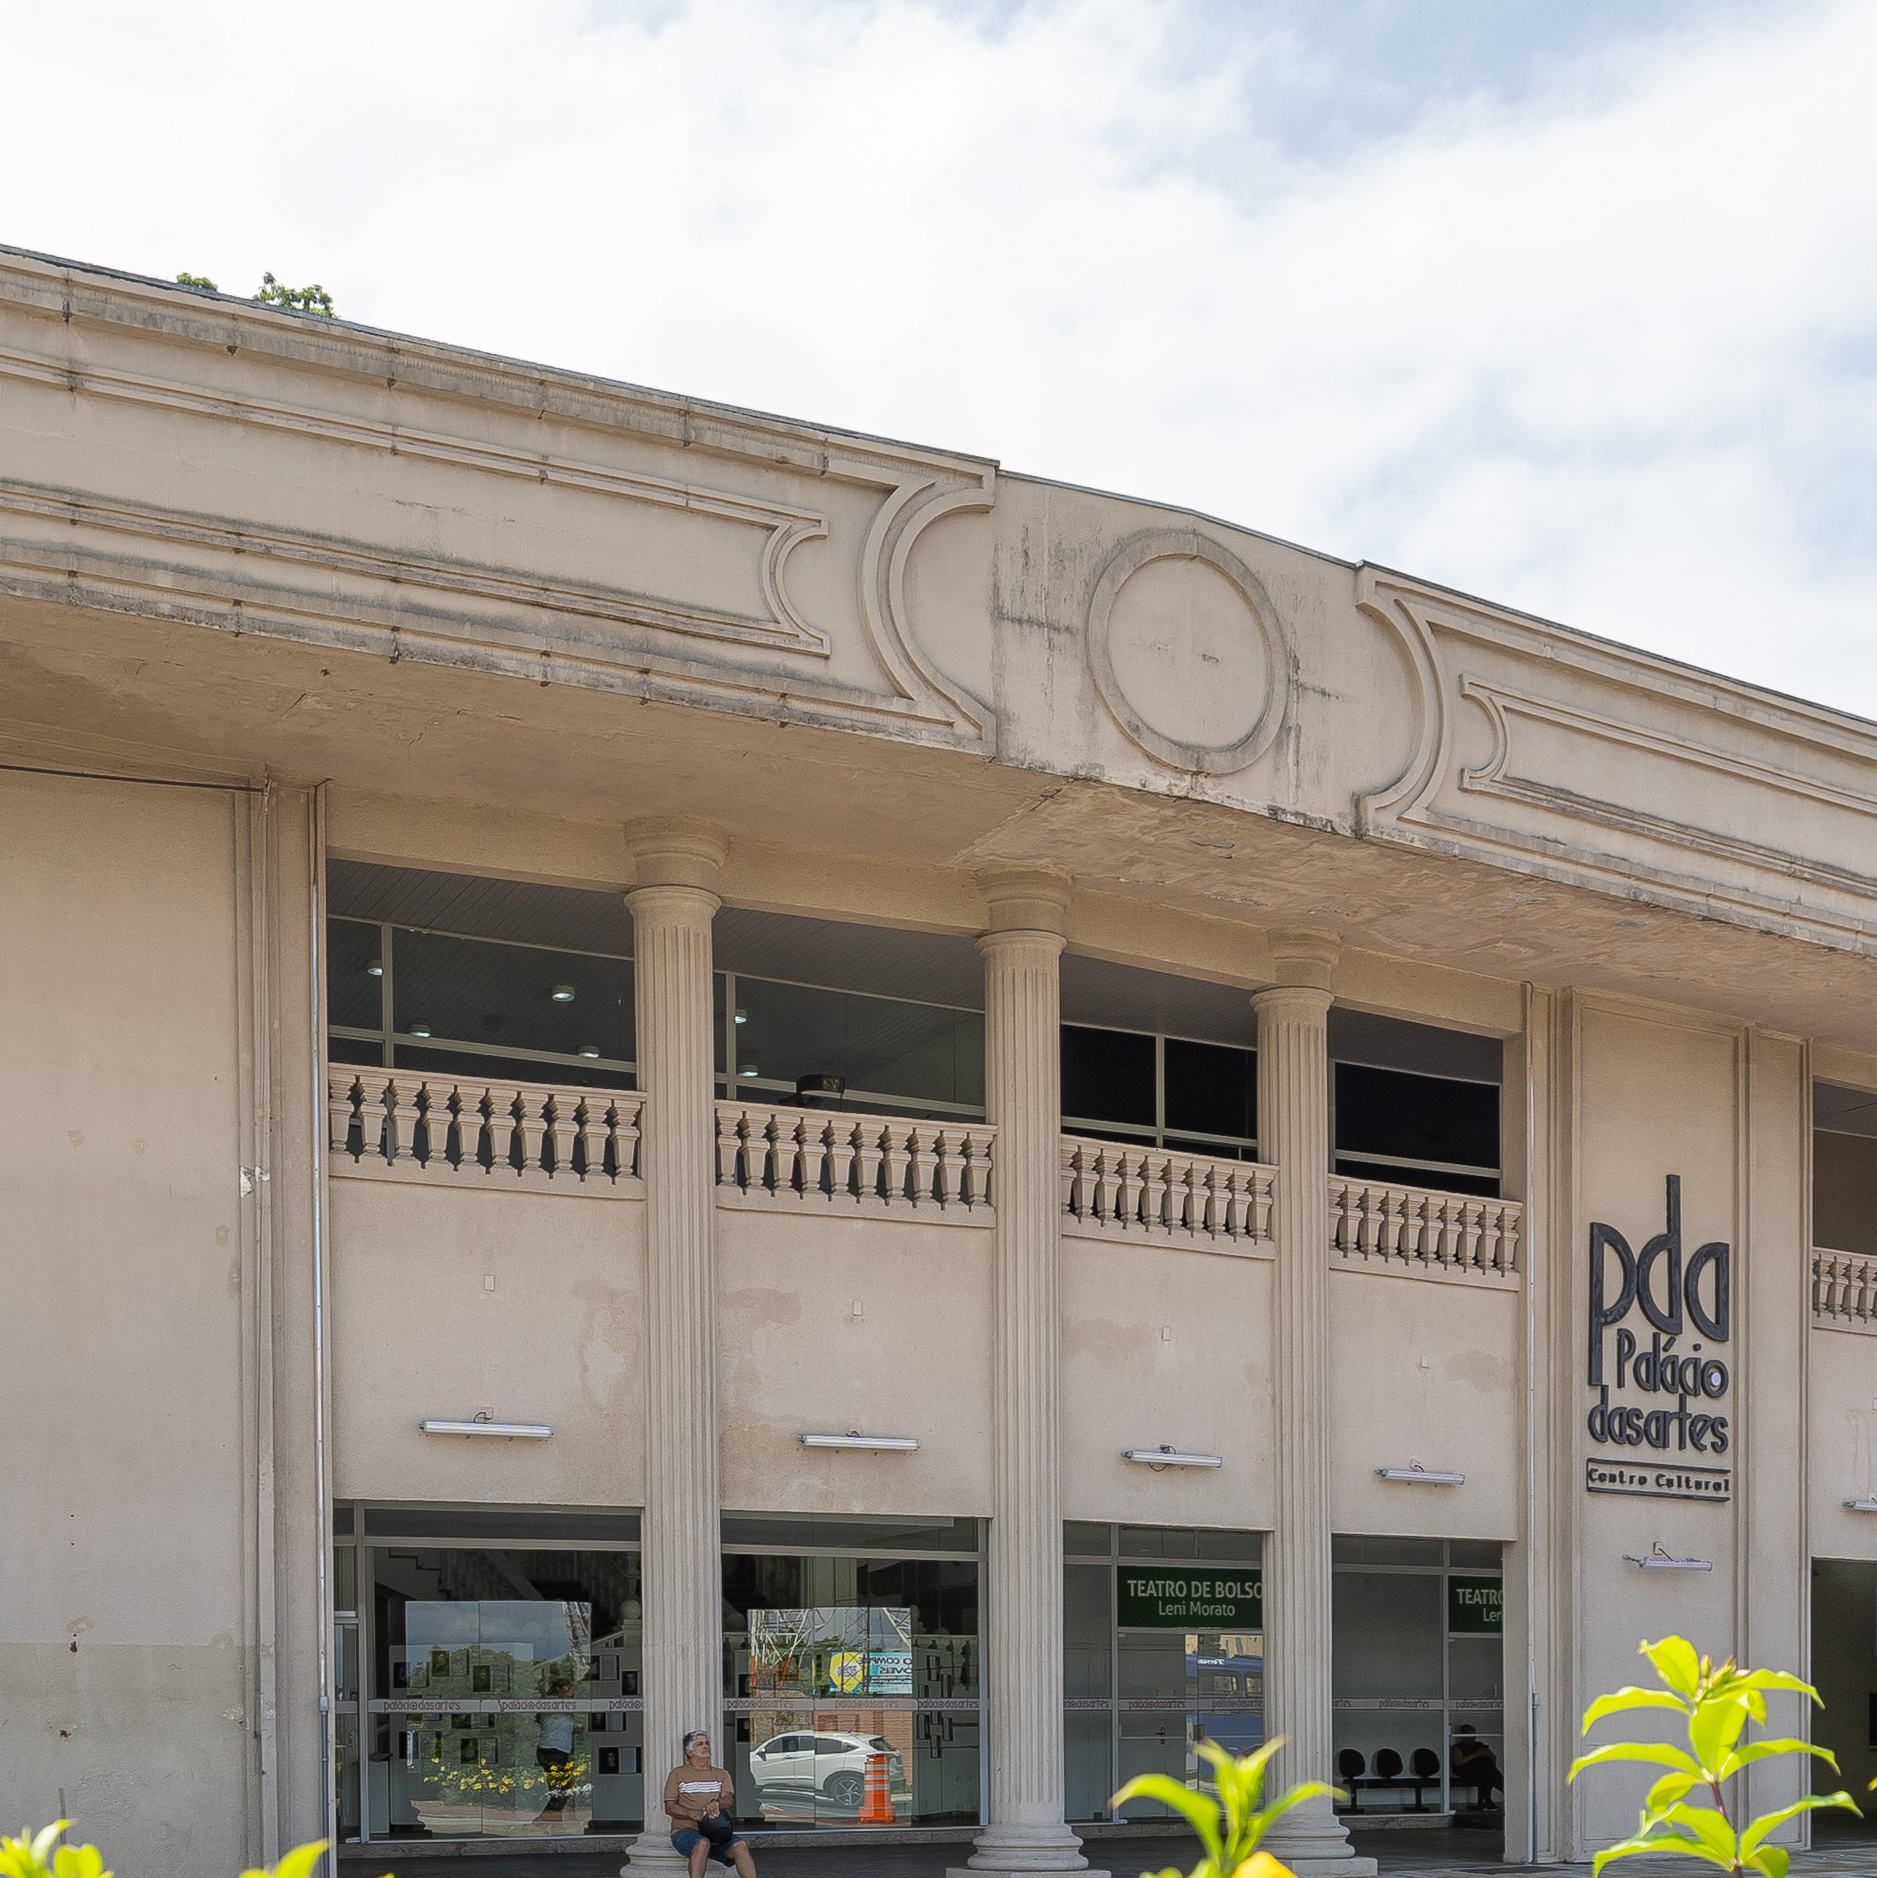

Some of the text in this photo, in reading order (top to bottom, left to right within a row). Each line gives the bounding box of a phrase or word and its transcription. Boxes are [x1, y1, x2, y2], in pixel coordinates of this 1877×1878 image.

[1588, 1174, 1730, 1386] pda
[1617, 1328, 1729, 1398] Palácio
[1587, 1384, 1729, 1453] dasartes
[1588, 1468, 1730, 1492] Centro Cultural
[1127, 1580, 1187, 1598] TEATRO
[1191, 1581, 1212, 1598] DE
[1158, 1600, 1235, 1617] Leni Morato
